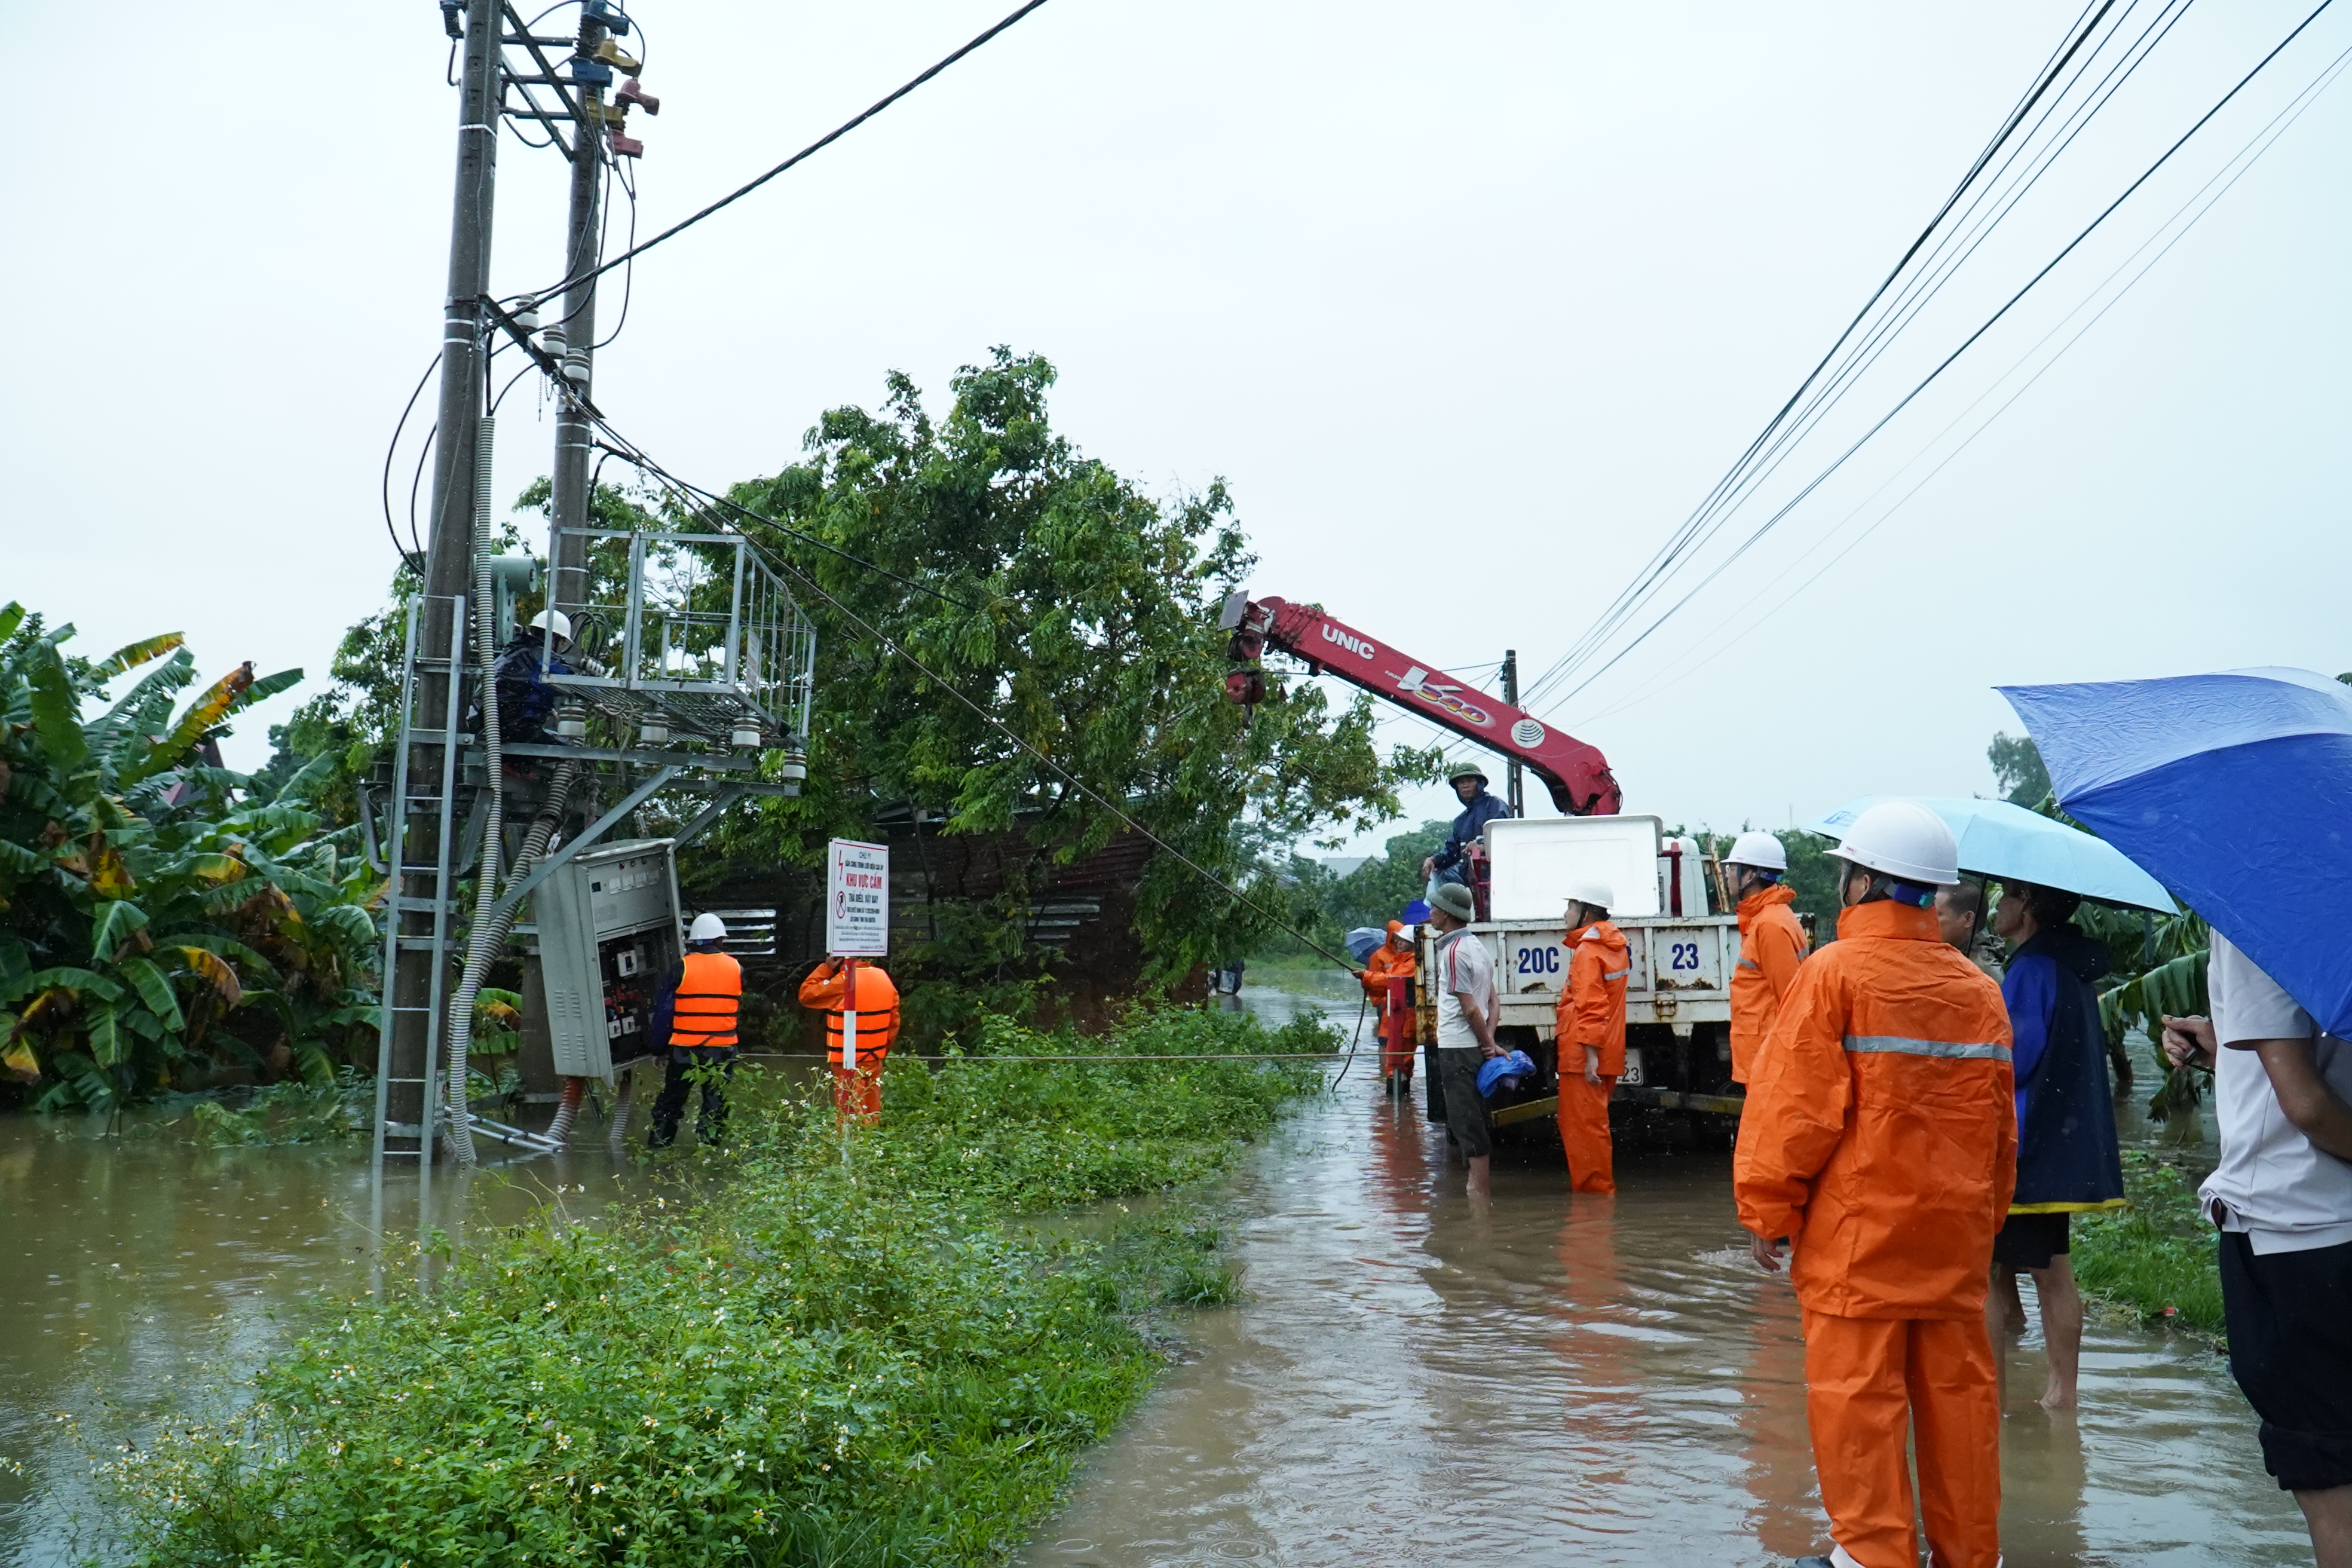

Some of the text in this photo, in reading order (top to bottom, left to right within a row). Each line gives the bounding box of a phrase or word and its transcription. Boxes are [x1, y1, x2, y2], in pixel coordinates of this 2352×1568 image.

[1321, 623, 1375, 660] UNIC
[846, 872, 857, 887] KHU
[870, 871, 882, 889] CẤM
[1518, 943, 1699, 973] 20C 23
